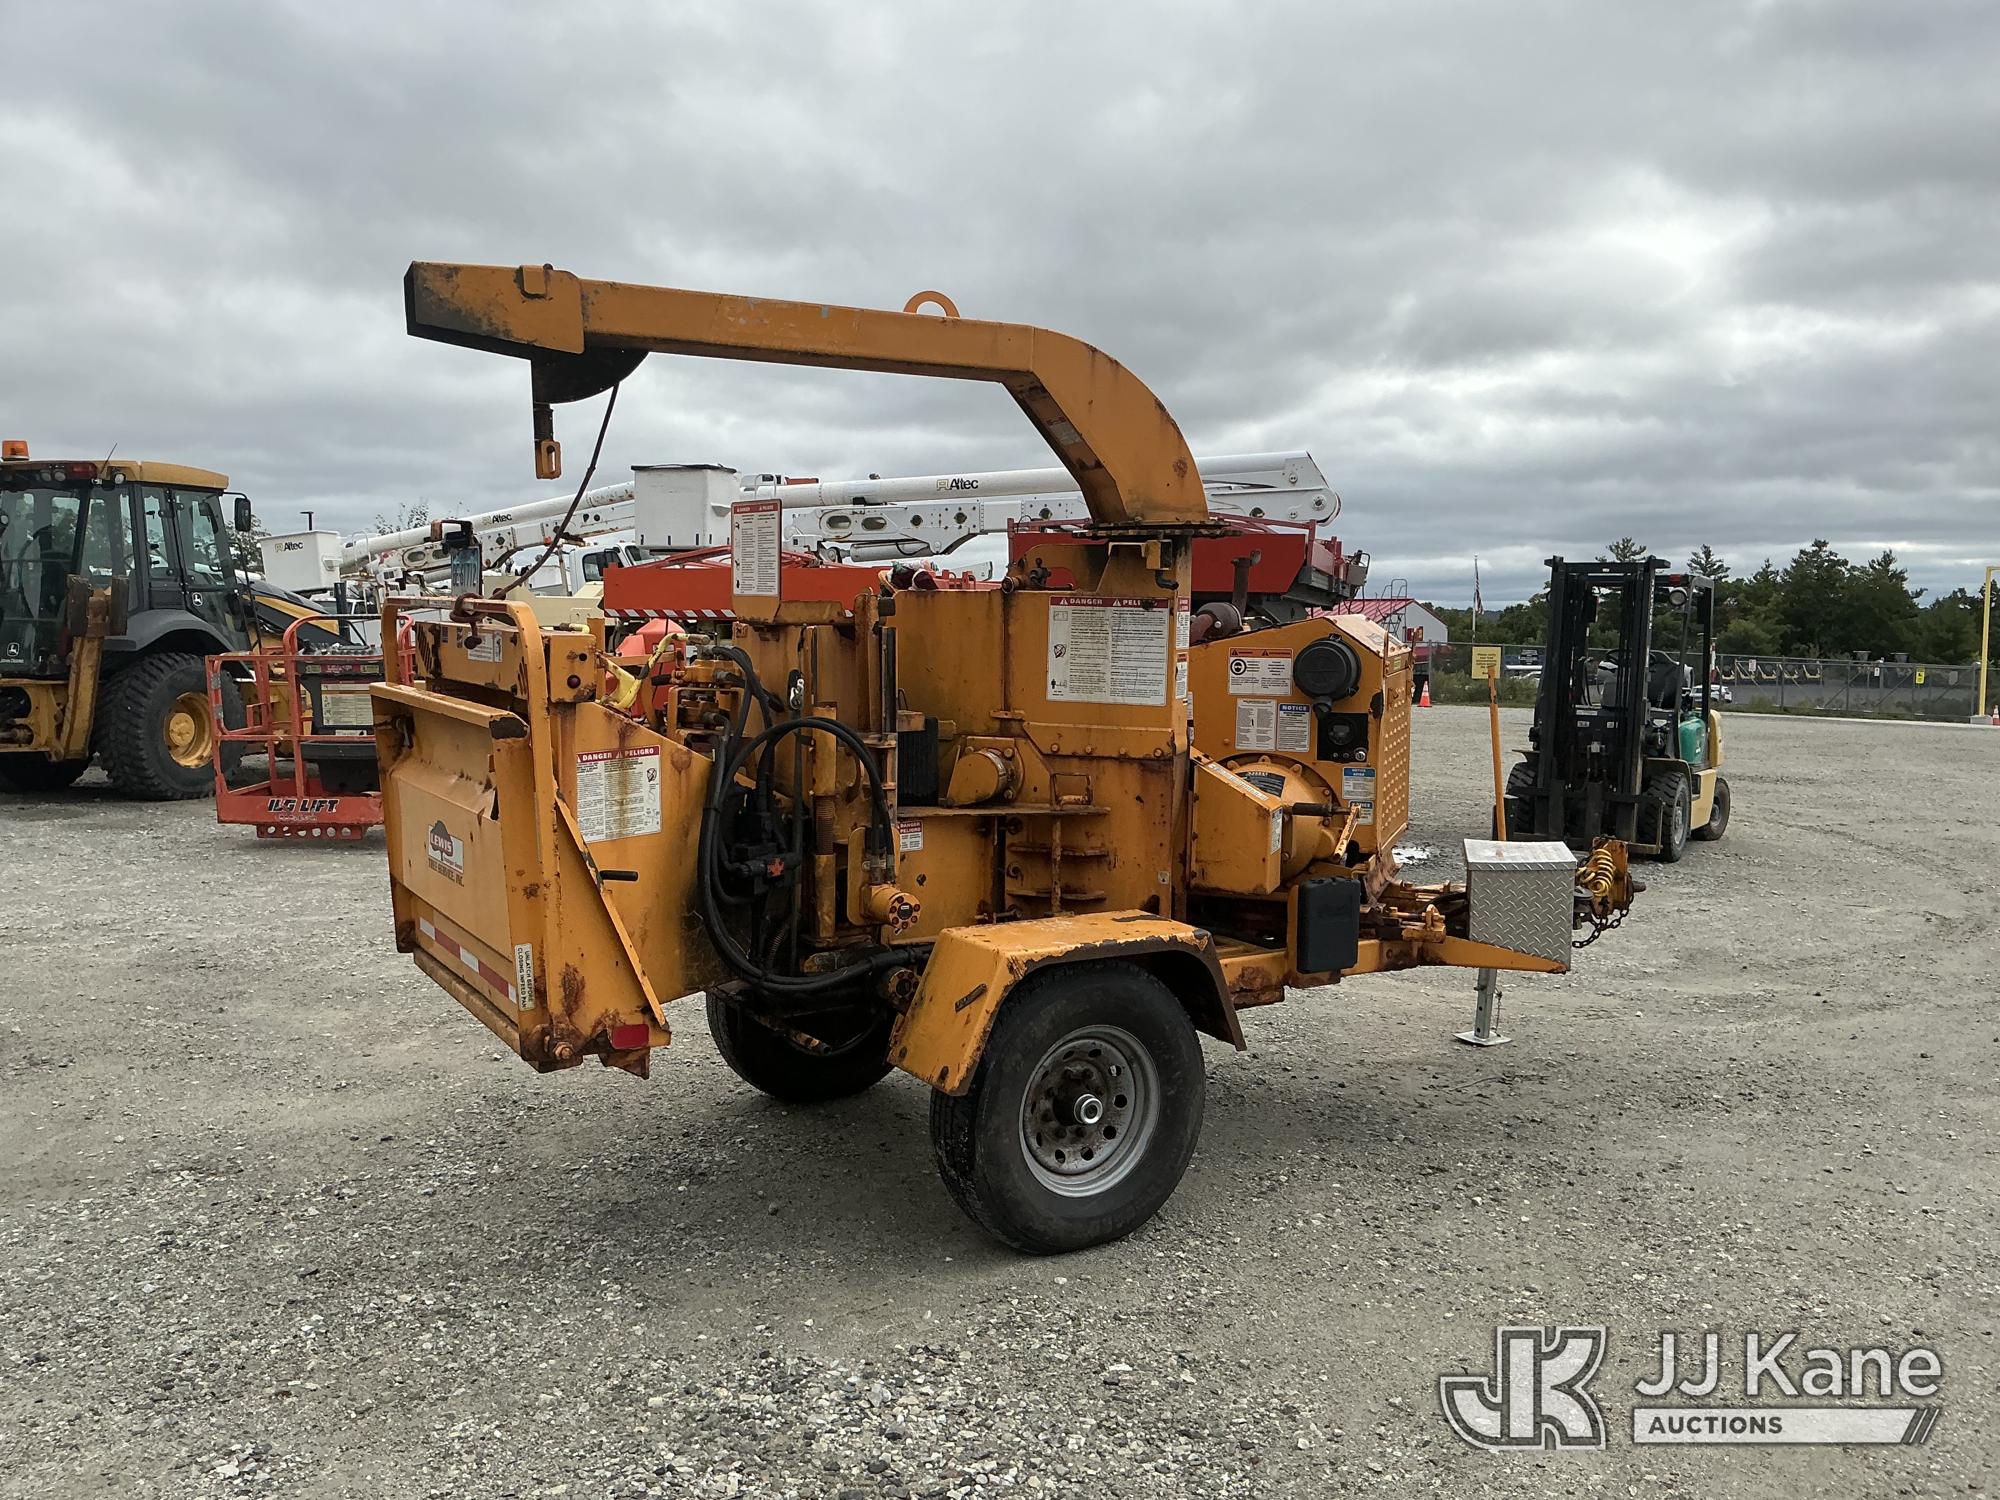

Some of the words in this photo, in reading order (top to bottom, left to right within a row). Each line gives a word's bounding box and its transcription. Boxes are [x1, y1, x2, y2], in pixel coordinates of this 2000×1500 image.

[951, 478, 979, 490] Altec
[492, 513, 512, 523] Altec
[284, 541, 304, 551] Altec
[582, 752, 612, 761] DANGER
[624, 748, 654, 757] PELIGRO
[299, 799, 339, 812] LIFT
[430, 832, 453, 853] LEWIS
